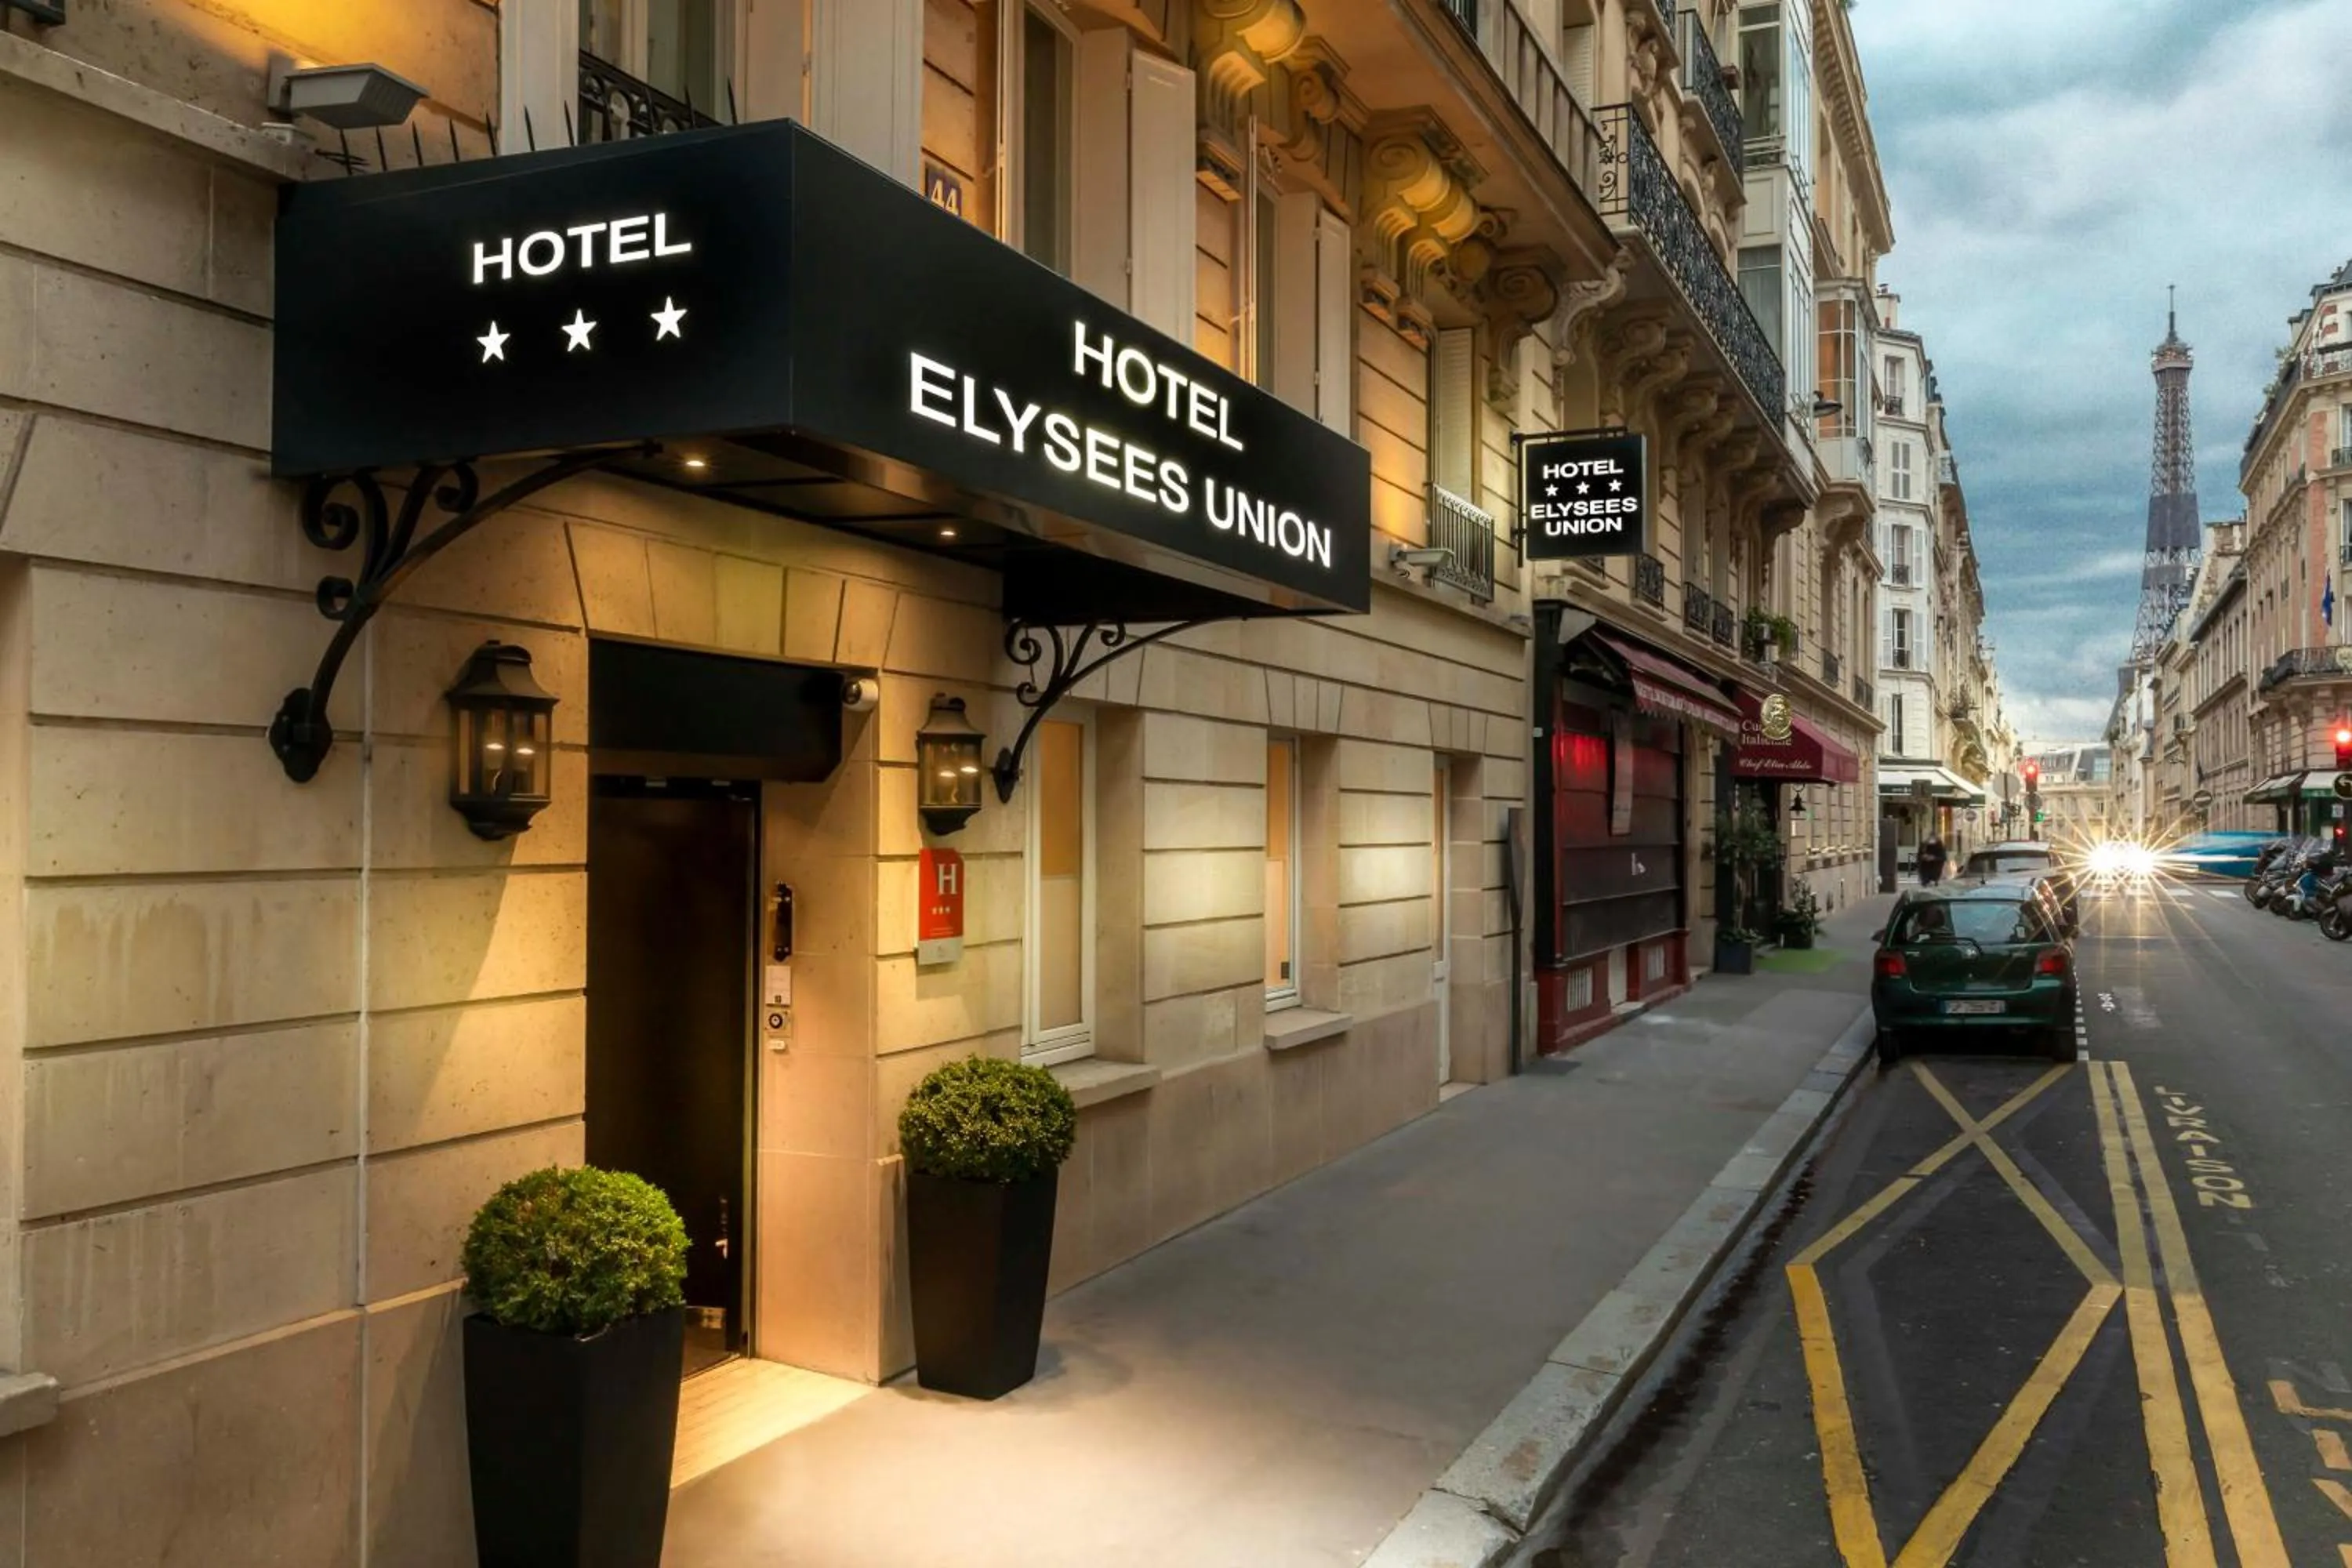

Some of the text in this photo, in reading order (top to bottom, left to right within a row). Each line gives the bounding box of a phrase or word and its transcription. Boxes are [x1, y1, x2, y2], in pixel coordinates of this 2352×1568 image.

[474, 212, 692, 285] HOTEL
[1074, 320, 1244, 451] HOTEL
[910, 352, 1331, 568] ELYSEES UNION
[1543, 459, 1624, 480] HOTEL
[1530, 496, 1639, 536] ELYSEES UNION
[938, 864, 958, 895] H
[2154, 1086, 2252, 1208] LIVRAISON
